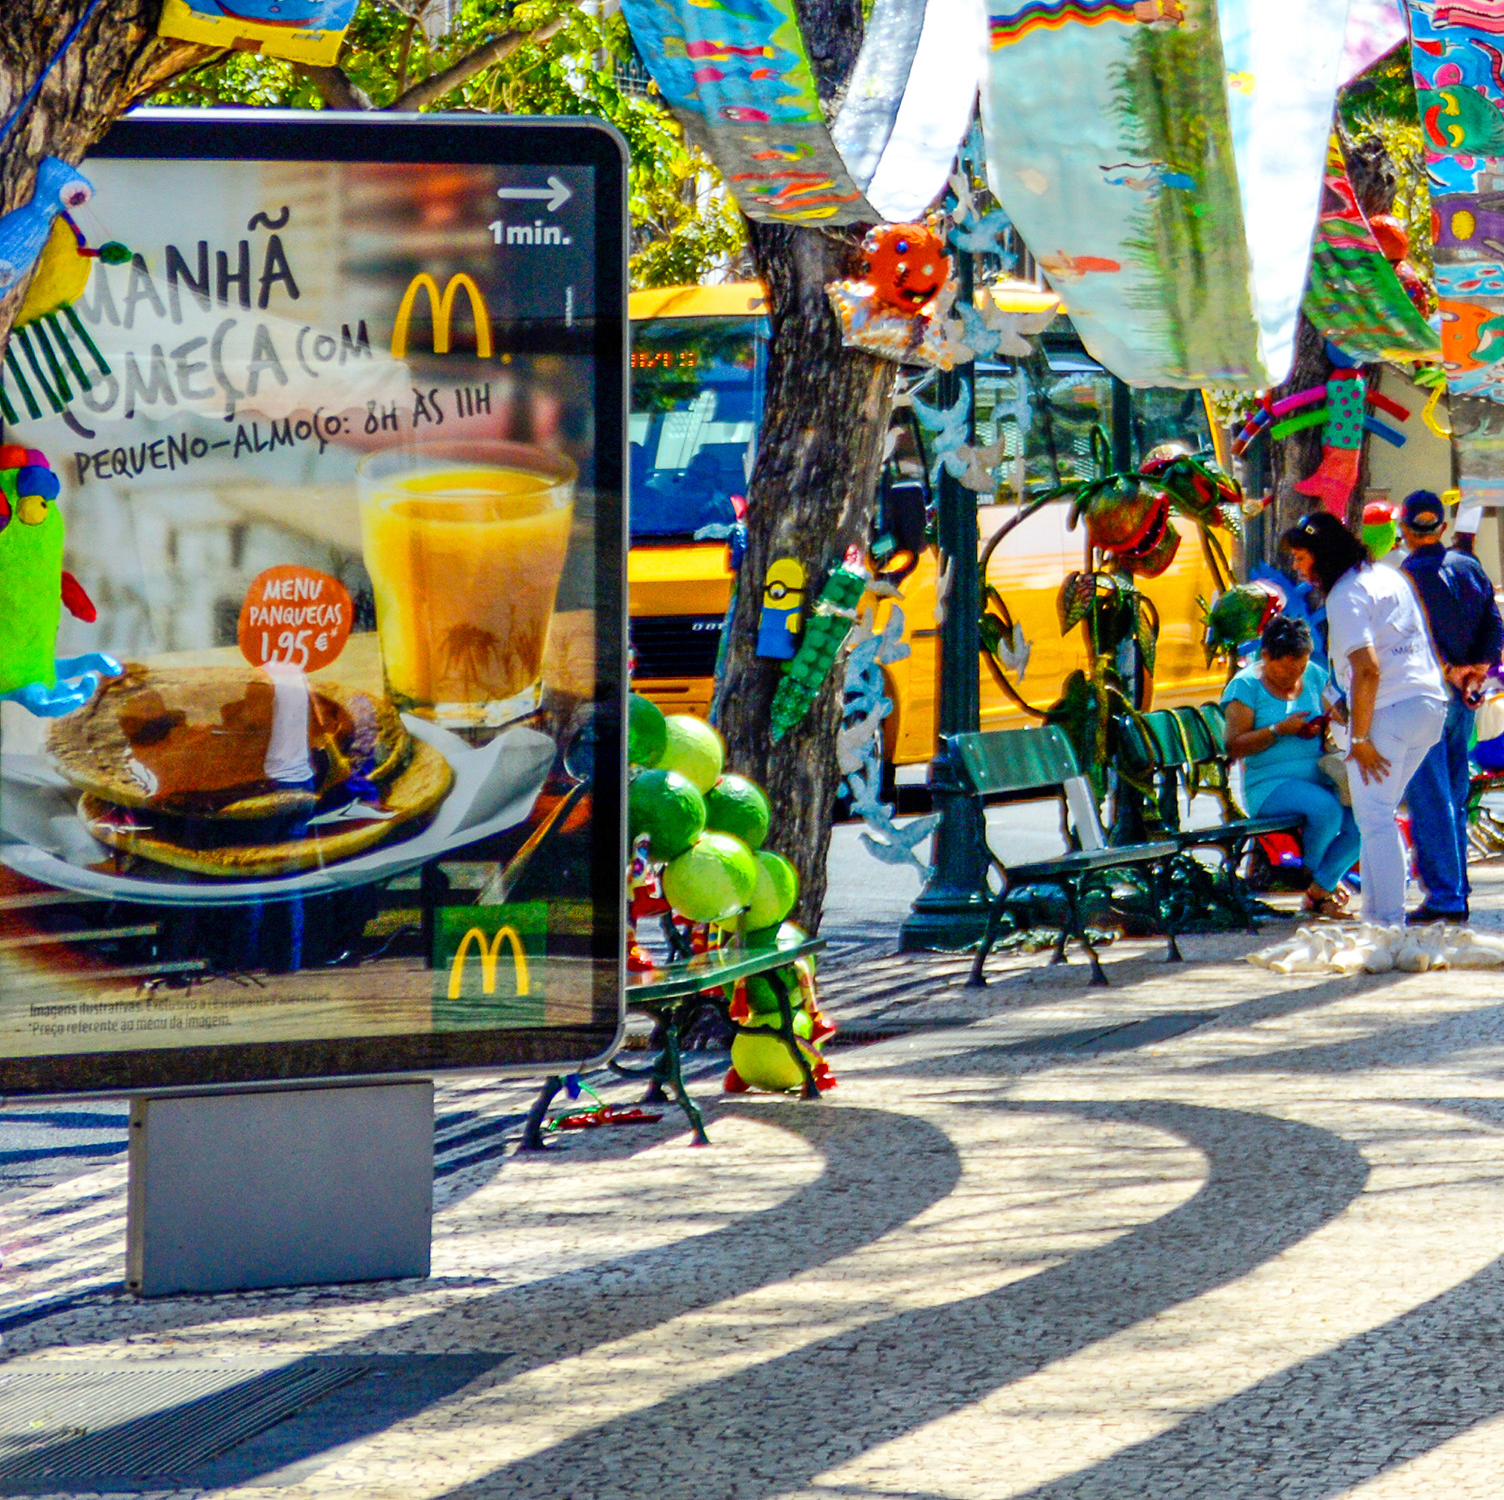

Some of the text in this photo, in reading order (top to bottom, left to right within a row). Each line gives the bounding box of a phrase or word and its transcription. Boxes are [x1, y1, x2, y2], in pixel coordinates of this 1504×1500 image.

[488, 219, 572, 246] 1min.
[69, 205, 300, 340] MANHÃ
[296, 319, 373, 378] COM
[364, 400, 398, 434] 8H
[411, 387, 444, 428] ÀS
[263, 577, 324, 602] MENU
[249, 603, 342, 627] PANQUECAS
[30, 1003, 77, 1018] Imagens
[66, 1020, 118, 1033] referente
[136, 1018, 167, 1030] menu
[169, 1016, 182, 1029] da
